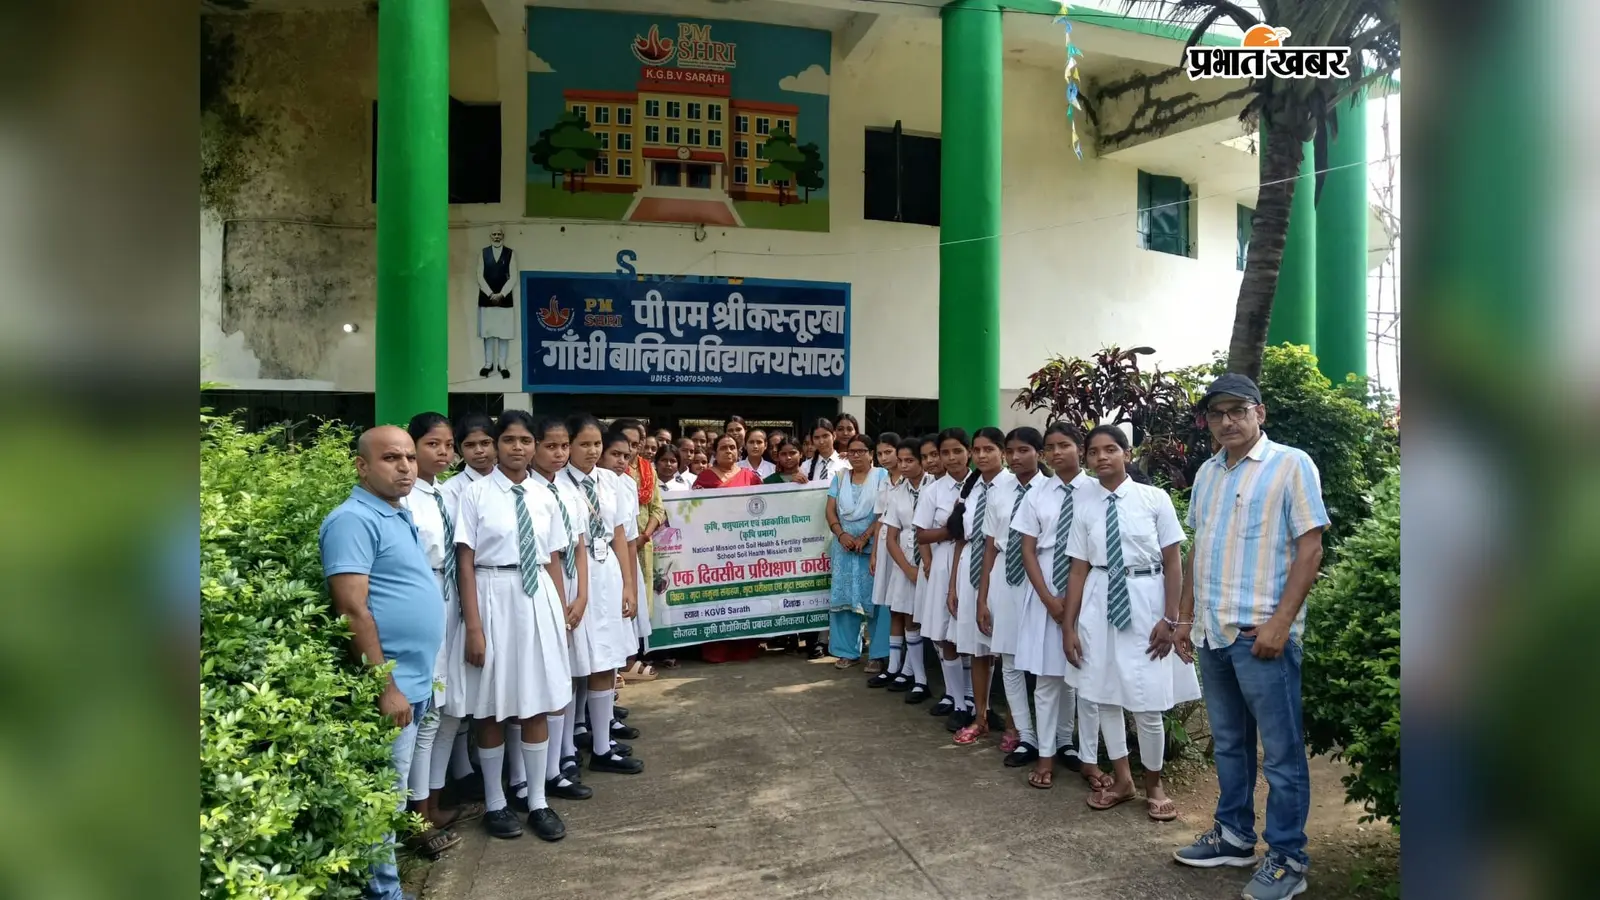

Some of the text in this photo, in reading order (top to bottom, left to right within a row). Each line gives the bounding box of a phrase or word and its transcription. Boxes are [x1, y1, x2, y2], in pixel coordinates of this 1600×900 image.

[677, 23, 712, 41] PM
[678, 40, 736, 63] SHRI
[646, 69, 725, 83] K.G.B.V SARATH
[584, 298, 613, 312] PM
[584, 313, 623, 328] SHRI
[631, 289, 845, 343] पी एम श्री कस्तूरबा
[609, 332, 699, 373] बालिका
[699, 335, 792, 375] विद्यालय
[791, 347, 845, 377] सारठ
[791, 514, 811, 524] विभाग
[692, 545, 714, 554] National
[716, 543, 736, 552] Mission
[746, 541, 757, 549] Soil
[758, 540, 774, 548] Health
[781, 538, 801, 546] Fertility
[717, 552, 736, 560] School
[748, 549, 766, 557] Health
[767, 547, 787, 556] Mission
[672, 569, 694, 587] एक
[698, 561, 745, 585] दिवसीय
[749, 558, 797, 579] प्रशिक्षण
[704, 607, 726, 617] KGVB
[727, 605, 751, 615] Sarath
[703, 623, 718, 638] कृषि
